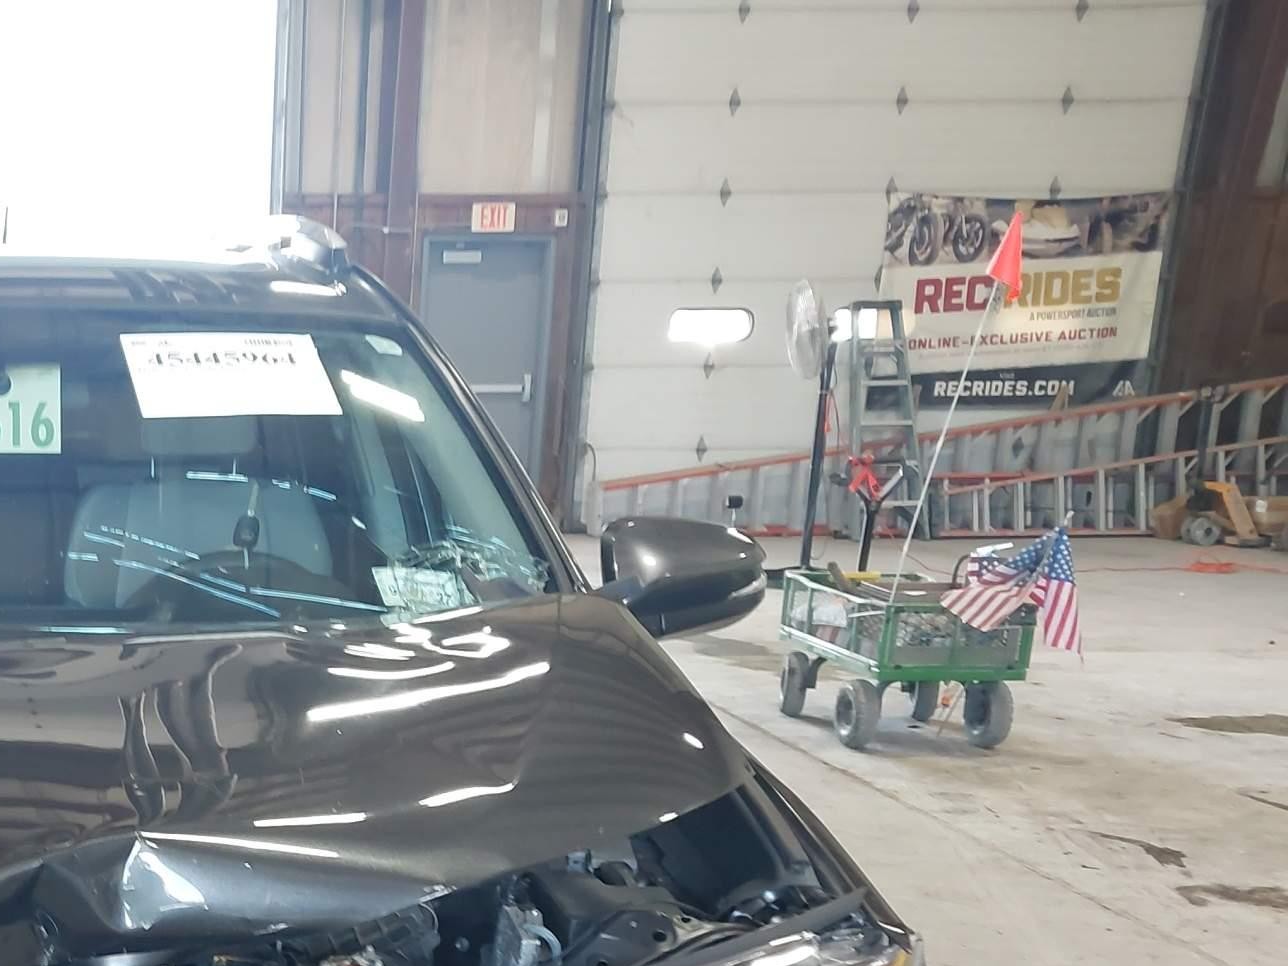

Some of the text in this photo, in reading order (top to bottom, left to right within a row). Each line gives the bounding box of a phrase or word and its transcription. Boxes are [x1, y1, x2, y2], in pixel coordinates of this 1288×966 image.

[480, 207, 509, 229] EXIT
[914, 275, 994, 315] REC
[1037, 308, 1085, 321] POWERSPORT
[1086, 306, 1117, 318] AUCTION
[1058, 327, 1118, 341] AUCTION
